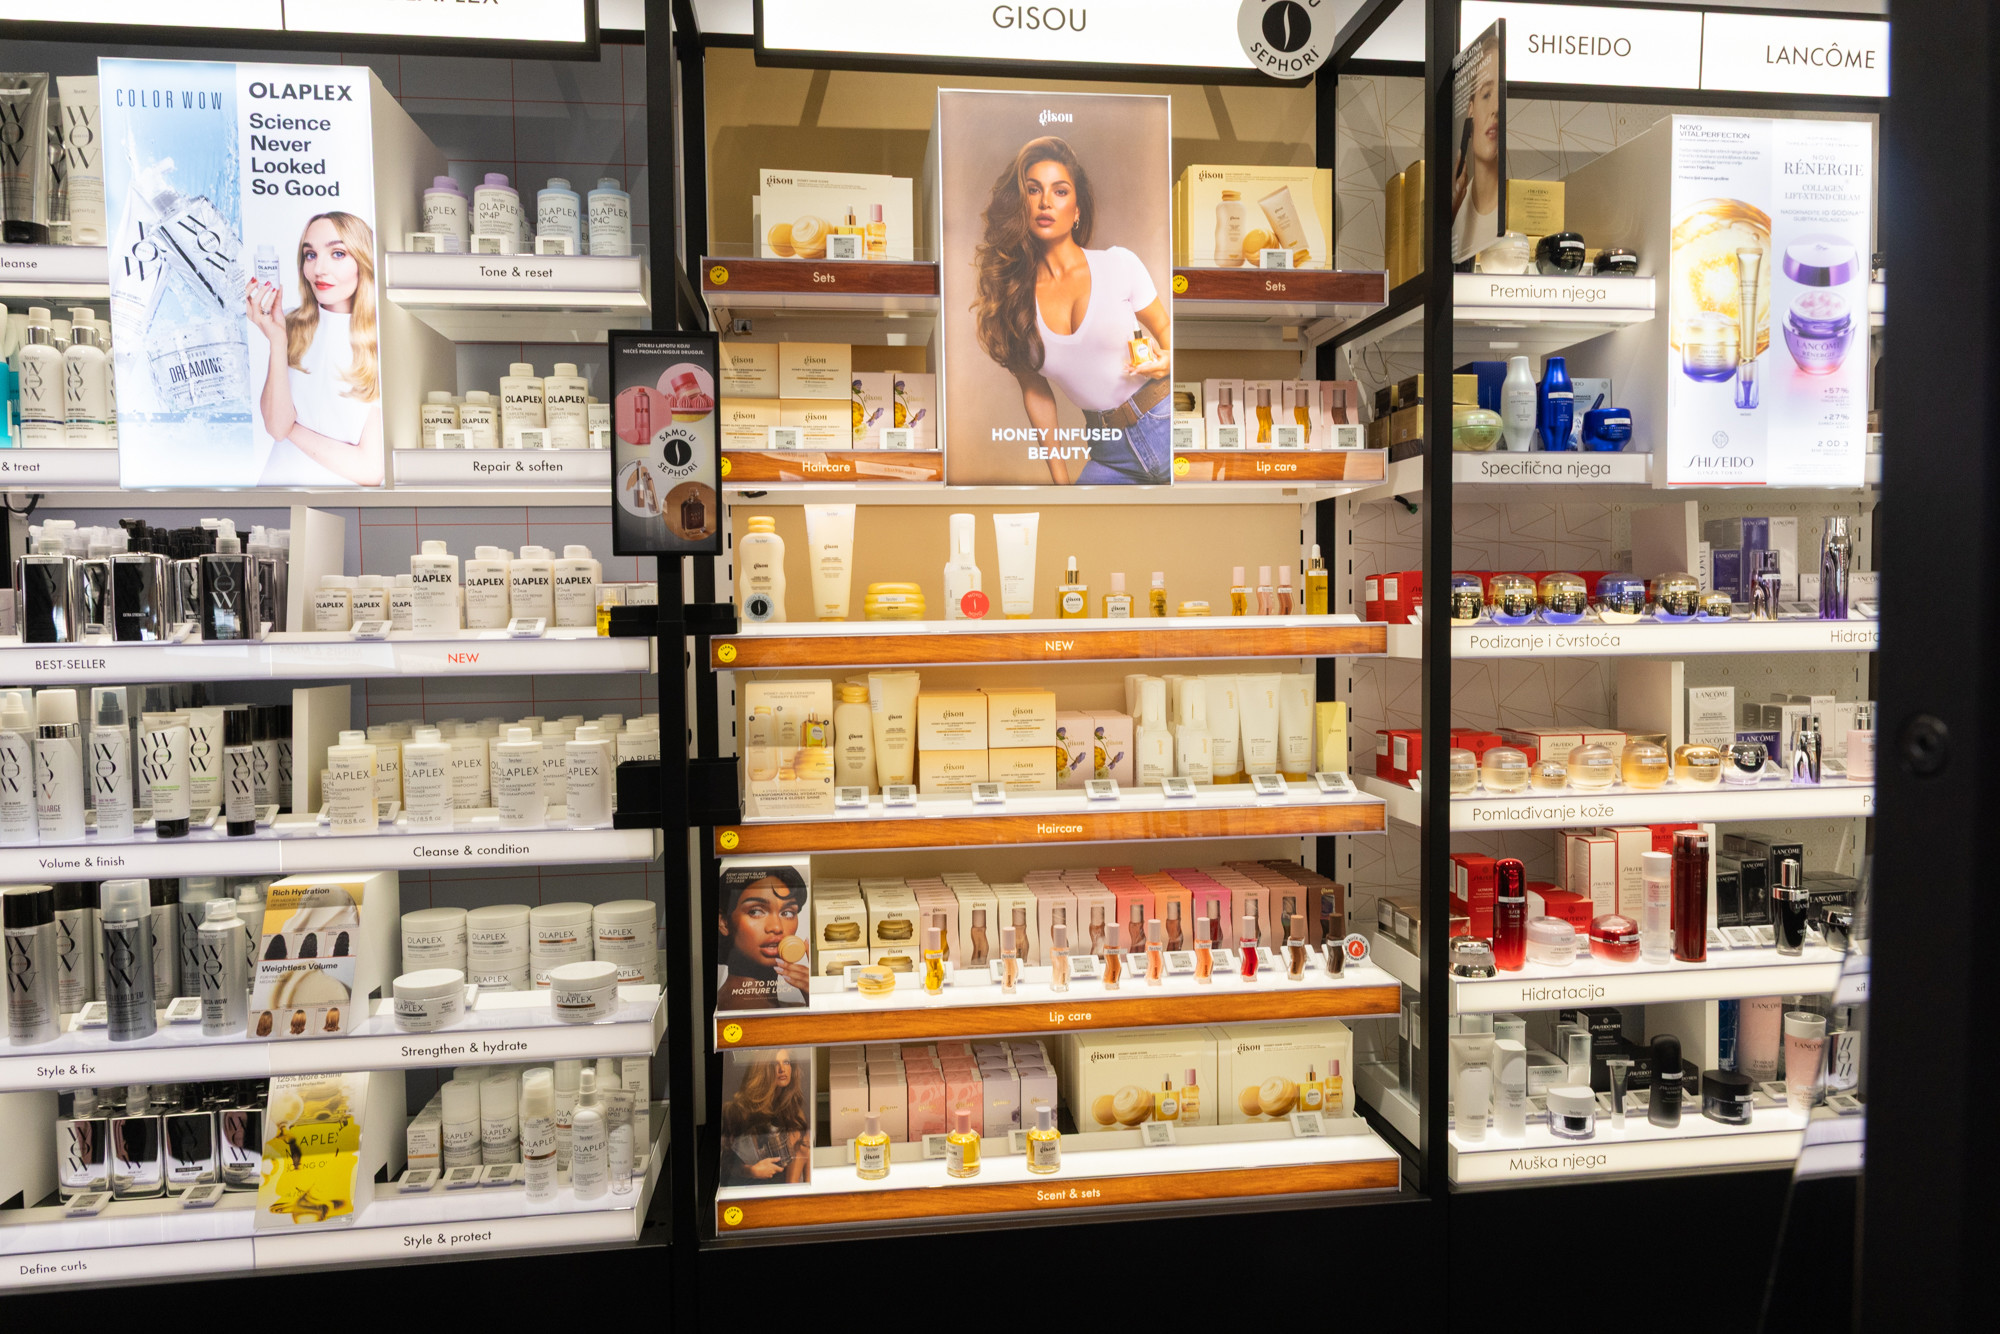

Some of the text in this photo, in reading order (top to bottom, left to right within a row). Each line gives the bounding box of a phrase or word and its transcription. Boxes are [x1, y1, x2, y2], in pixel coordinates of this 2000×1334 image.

[992, 5, 1087, 32] GISOU
[1528, 34, 1631, 57] SHISEIDO
[1250, 42, 1319, 72] SEPHORI
[1766, 43, 1876, 69] LANCÔME
[249, 82, 353, 102] OLAPLEX
[116, 88, 222, 110] COLOR WOW
[249, 113, 331, 131] Science
[1039, 109, 1073, 126] gisou
[66, 106, 98, 169] WOW
[1701, 131, 1750, 139] PERFECTION
[251, 135, 312, 152] Never
[251, 158, 326, 175] Looked
[1784, 159, 1864, 176] RÉNERGIE
[766, 175, 793, 187] gisou
[1198, 170, 1223, 182] gisou
[252, 180, 340, 197] So Good
[1802, 184, 1844, 192] COLLAGEN
[1785, 192, 1831, 200] LIFT-XTEND
[479, 203, 519, 217] OLAPLEX
[538, 208, 578, 218] OLAPLEX
[590, 208, 629, 219] OLAPLEX
[0, 257, 38, 270] leanse
[479, 266, 553, 278] Tone & reset
[813, 271, 836, 283] Sets
[1265, 281, 1286, 292] Sets
[1490, 284, 1607, 301] Premium njega
[731, 355, 754, 366] gisou
[804, 355, 826, 366] gisou
[505, 395, 543, 404] OLAPLEX
[548, 395, 585, 404] OLAPLEX
[424, 417, 452, 425] OLAPLEX
[462, 417, 489, 425] OLAPLEX
[733, 412, 756, 422] gisou
[805, 412, 828, 422] gisou
[659, 429, 697, 442] SAMO U
[991, 428, 1123, 442] HONEY INFUSED
[1028, 446, 1092, 460] BEAUTY
[1, 461, 40, 472] & treat
[802, 461, 850, 472] Haircare
[1683, 454, 1754, 468] SHISEIDO
[473, 460, 563, 475] Repair & soften
[657, 462, 698, 477] SEPHORI
[1256, 461, 1297, 474] Lip care
[1481, 461, 1611, 477] Specifična njega
[413, 575, 452, 583] OLAPLEX
[467, 578, 504, 586] OLAPLEX
[513, 577, 549, 585] OLAPLEX
[556, 577, 592, 585] OLAPLEX
[1045, 640, 1074, 651] NEW
[1470, 632, 1620, 651] Podizanje i čvrstoća
[35, 659, 106, 670] BEST-SELLER
[448, 653, 480, 664] NEW
[1695, 691, 1728, 699] LANCÔME
[942, 709, 964, 720] gisou
[1012, 708, 1033, 718] gisou
[146, 732, 176, 780] WOW
[94, 743, 120, 794] WOW
[943, 763, 965, 773] gisou
[1013, 761, 1034, 770] gisou
[1473, 804, 1614, 822] Pomlađivanje kože
[1037, 823, 1083, 834] Haircare
[413, 844, 530, 858] Cleanse & condition
[39, 856, 125, 869] Volume & finish
[291, 887, 330, 896] Hydration
[1809, 894, 1842, 903] LANCÔME
[472, 933, 507, 941] OLAPLEX
[538, 930, 574, 939] OLAPLEX
[599, 928, 632, 936] OLAPLEX
[407, 936, 442, 945] OLAPLEX
[261, 962, 338, 973] Weightless Volume
[474, 975, 509, 984] OLAPLEX
[1522, 984, 1605, 1001] Hidratacija
[557, 995, 592, 1004] OLAPLEX
[1049, 1011, 1092, 1024] Lip care
[401, 1040, 528, 1059] Strengthen & hydrate
[1237, 1043, 1261, 1054] gisou
[1090, 1052, 1115, 1063] gisou
[37, 1063, 95, 1079] Style & fix
[523, 1135, 556, 1148] OLAPLEX
[573, 1142, 606, 1152] OLAPLEX
[1509, 1153, 1607, 1171] Muška njega
[1037, 1188, 1101, 1201] Scent & sets
[403, 1231, 492, 1249] Style & protect
[20, 1261, 87, 1275] Define curls
